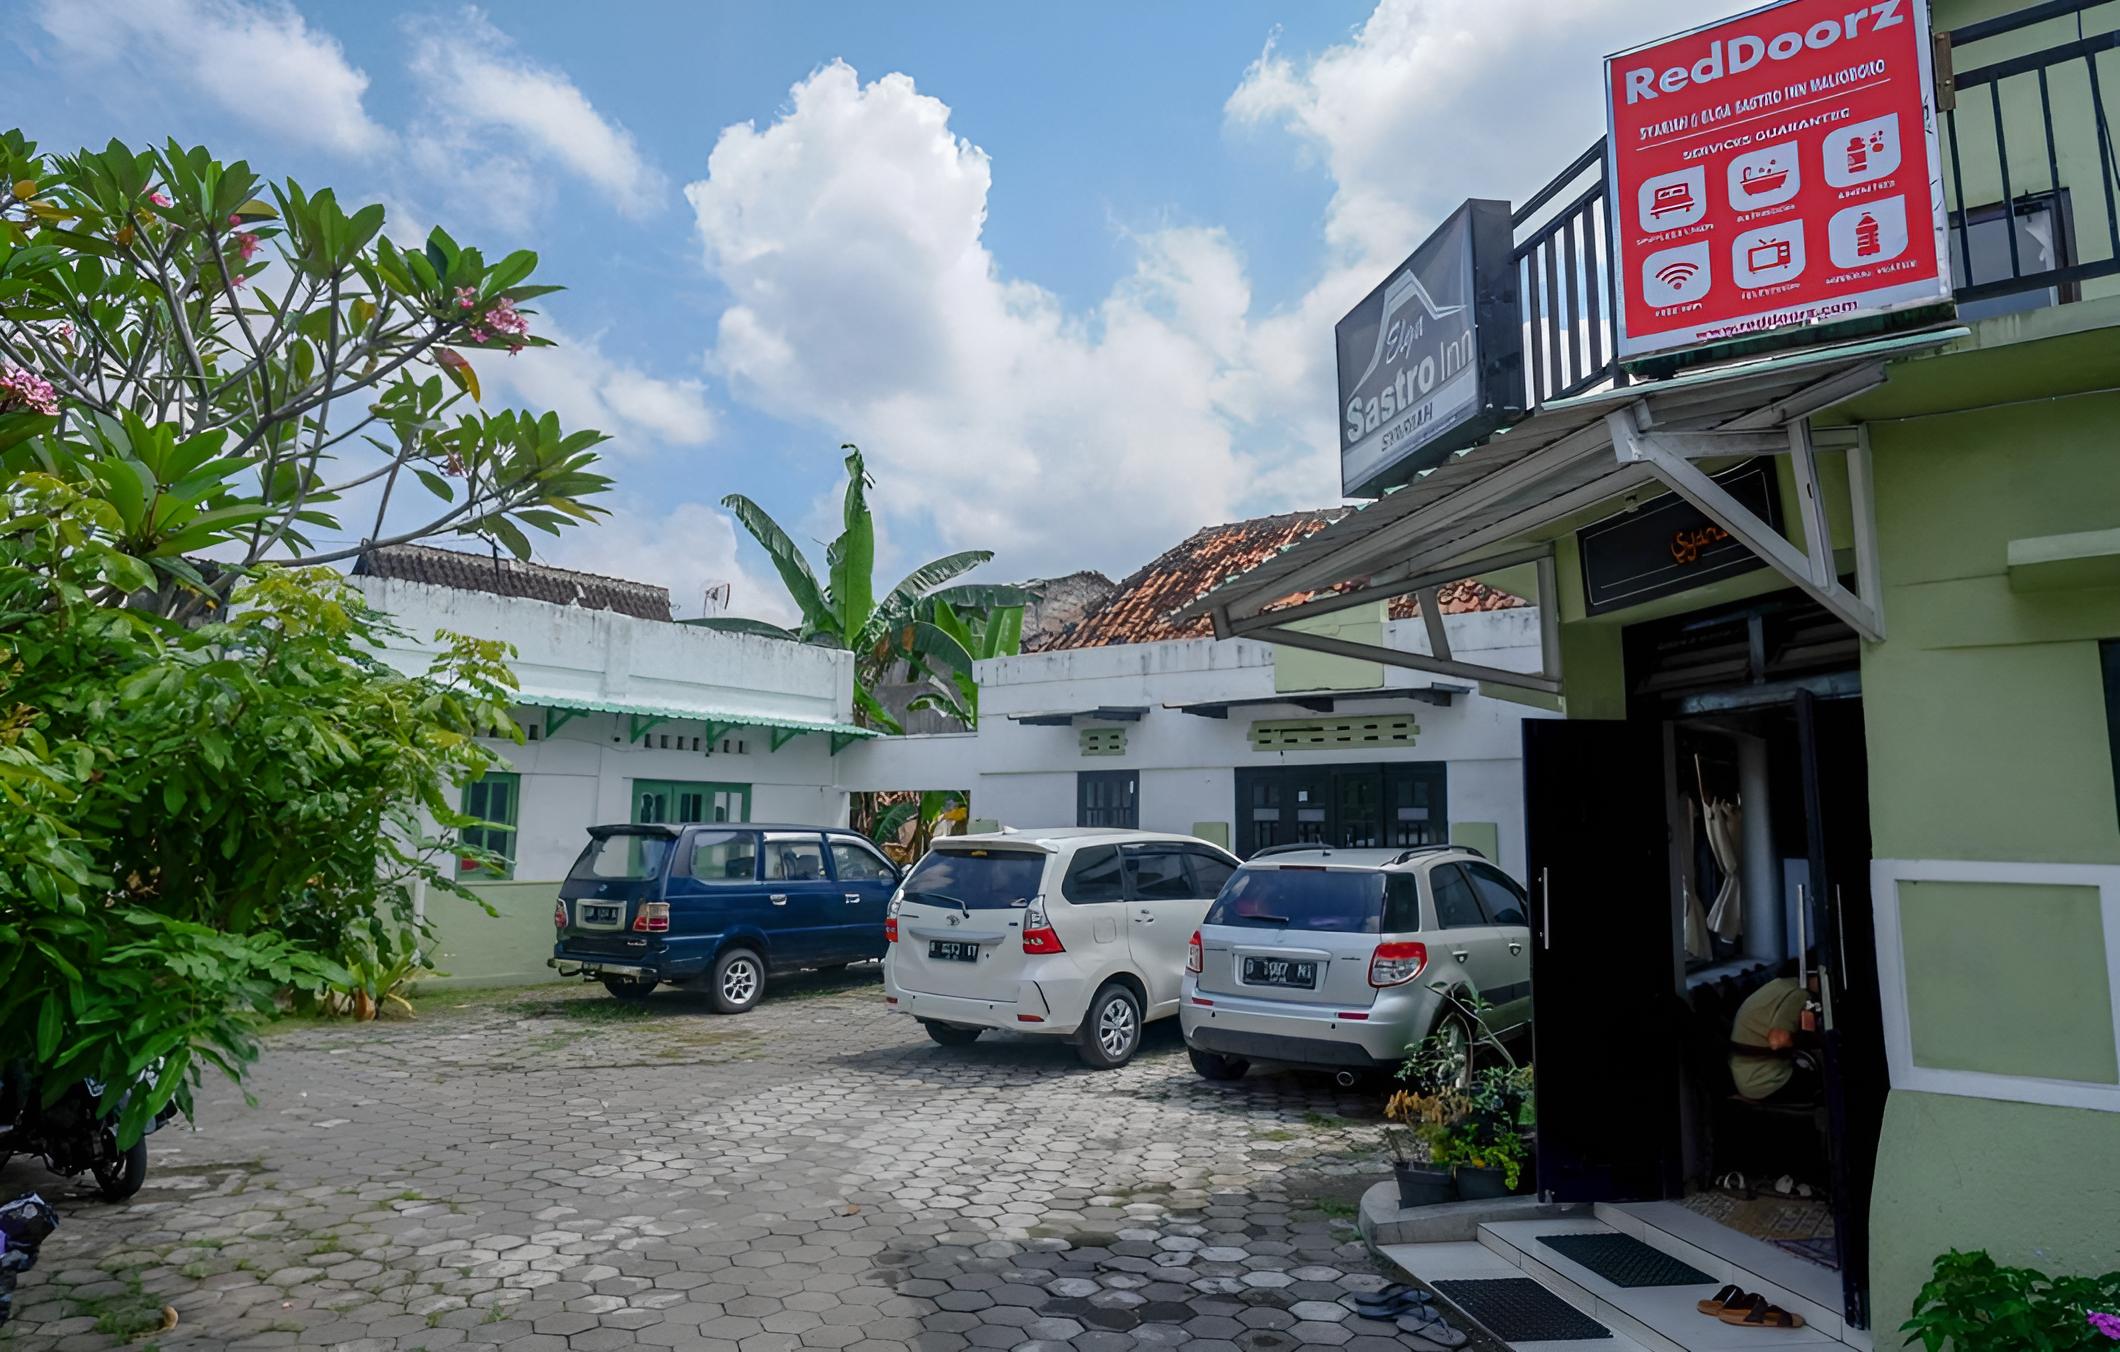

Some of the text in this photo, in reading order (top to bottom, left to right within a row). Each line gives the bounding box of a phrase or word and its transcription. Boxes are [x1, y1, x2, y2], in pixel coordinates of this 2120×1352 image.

[1627, 0, 1903, 103] RedDoorz
[1347, 329, 1473, 443] Sastro Inn
